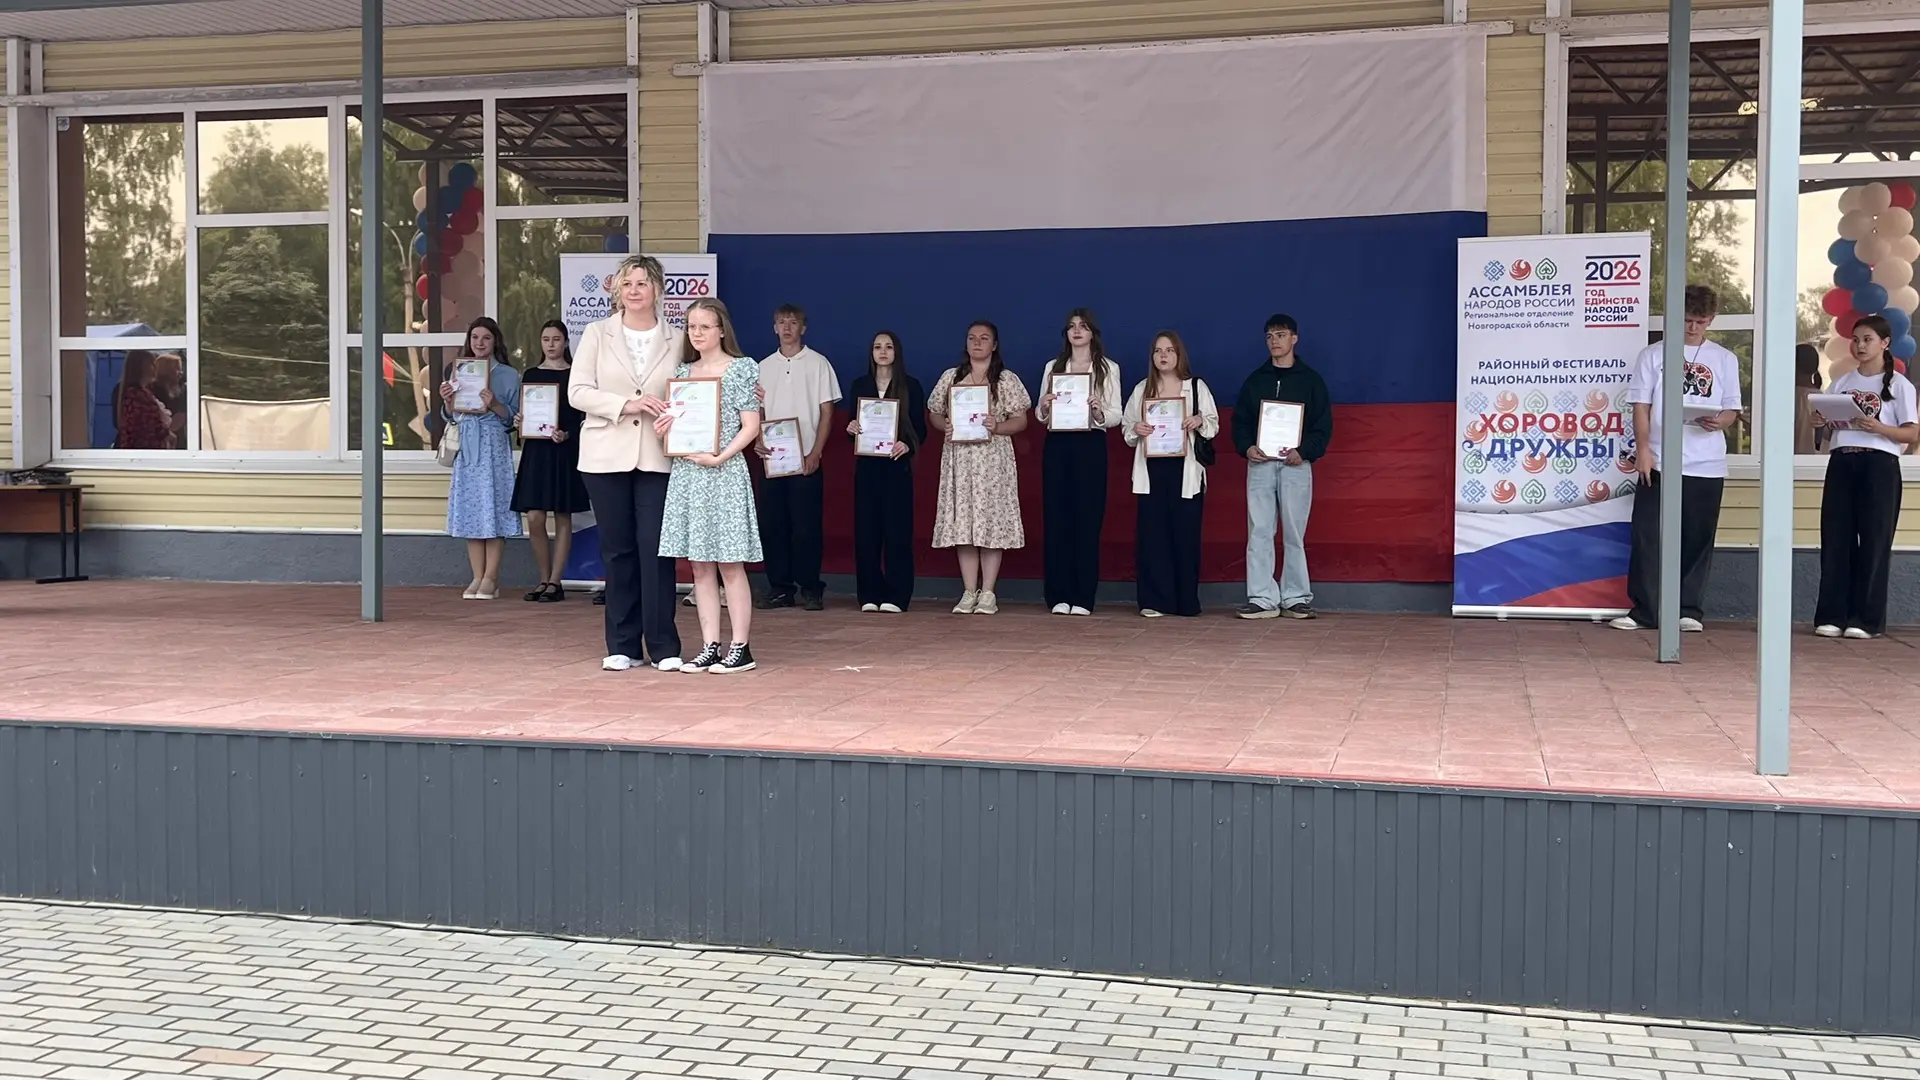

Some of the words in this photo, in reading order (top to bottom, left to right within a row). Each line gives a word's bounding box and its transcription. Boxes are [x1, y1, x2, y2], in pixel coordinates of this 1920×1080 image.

[1584, 260, 1641, 281] 2026
[664, 278, 710, 296] 2026
[1468, 283, 1572, 298] АССАМБЛЕЯ
[1584, 289, 1606, 298] ГОД
[663, 302, 680, 310] ГОД
[1464, 299, 1521, 310] НАРОДОВ
[1524, 298, 1575, 308] РОССИИ
[1584, 297, 1640, 306] ЕДИНСТВА
[1464, 311, 1525, 320] Региональное
[1527, 310, 1574, 318] отделение
[1584, 306, 1634, 314] НАРОДОВ
[1584, 314, 1628, 323] РОССИИ
[1468, 321, 1532, 331] Новгородской
[1534, 320, 1570, 329] области
[1478, 358, 1550, 370] РАЙОННЫЙ
[1552, 358, 1627, 369] ФЕСТИВАЛЬ
[1471, 374, 1577, 385] НАЦИОНАЛЬНЫХ
[1479, 412, 1625, 436] ХОРОВОД
[1486, 438, 1615, 461] ДРУЖБЫ
